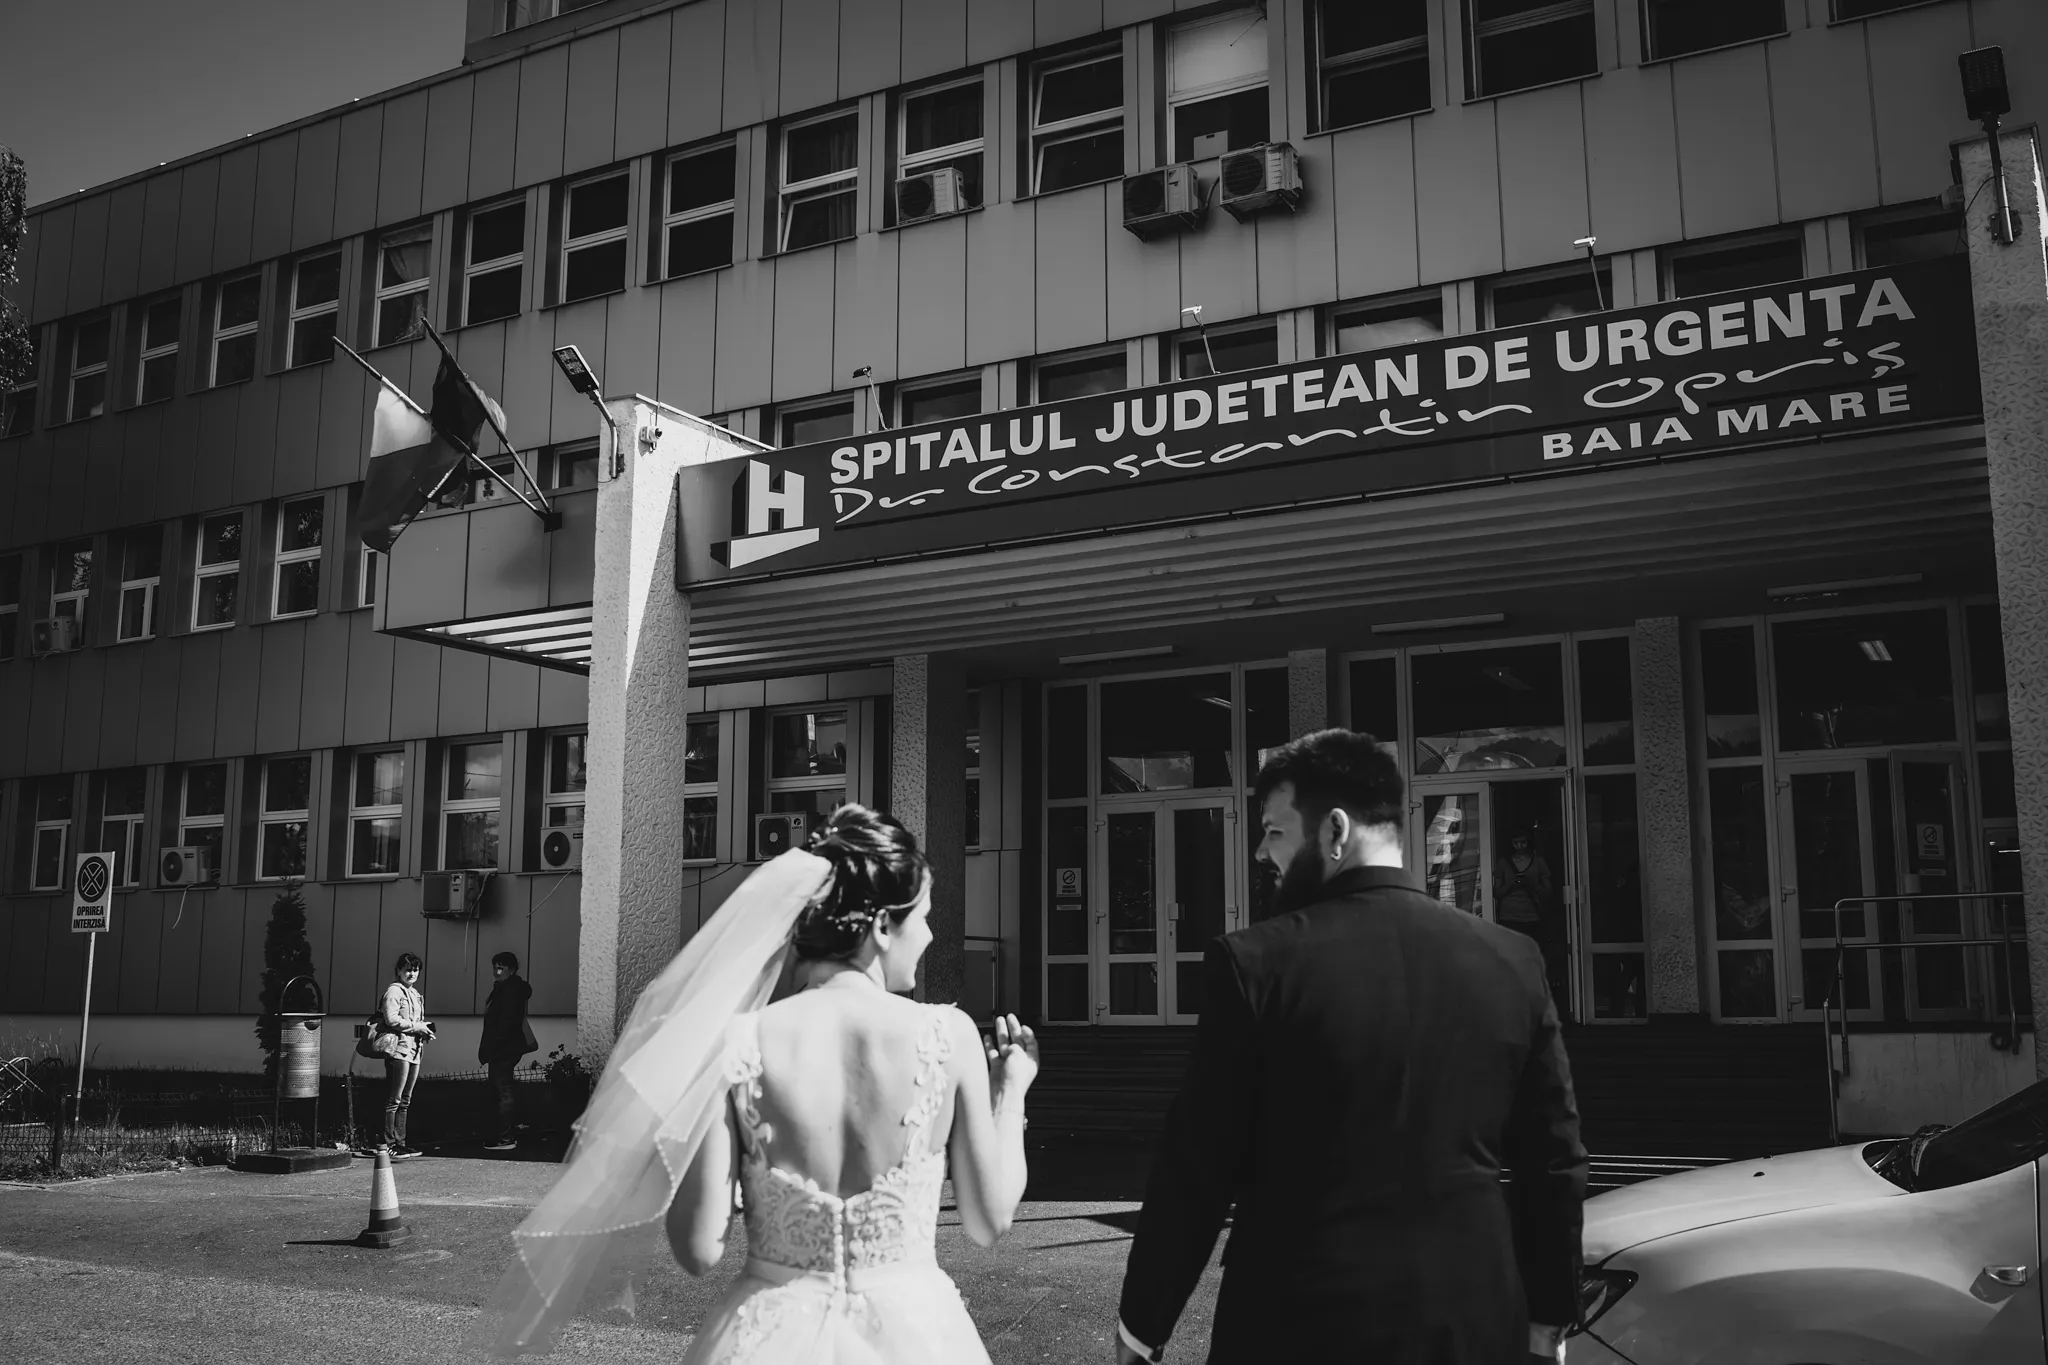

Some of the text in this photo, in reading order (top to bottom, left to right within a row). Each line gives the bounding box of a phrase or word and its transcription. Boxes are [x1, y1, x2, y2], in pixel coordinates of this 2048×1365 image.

[830, 277, 1916, 484] SPITALUL JUDETEAN DE URGENTA
[1542, 385, 1911, 460] BAIA MARE
[968, 398, 1533, 494] Constantin
[76, 905, 104, 916] OPRIREA
